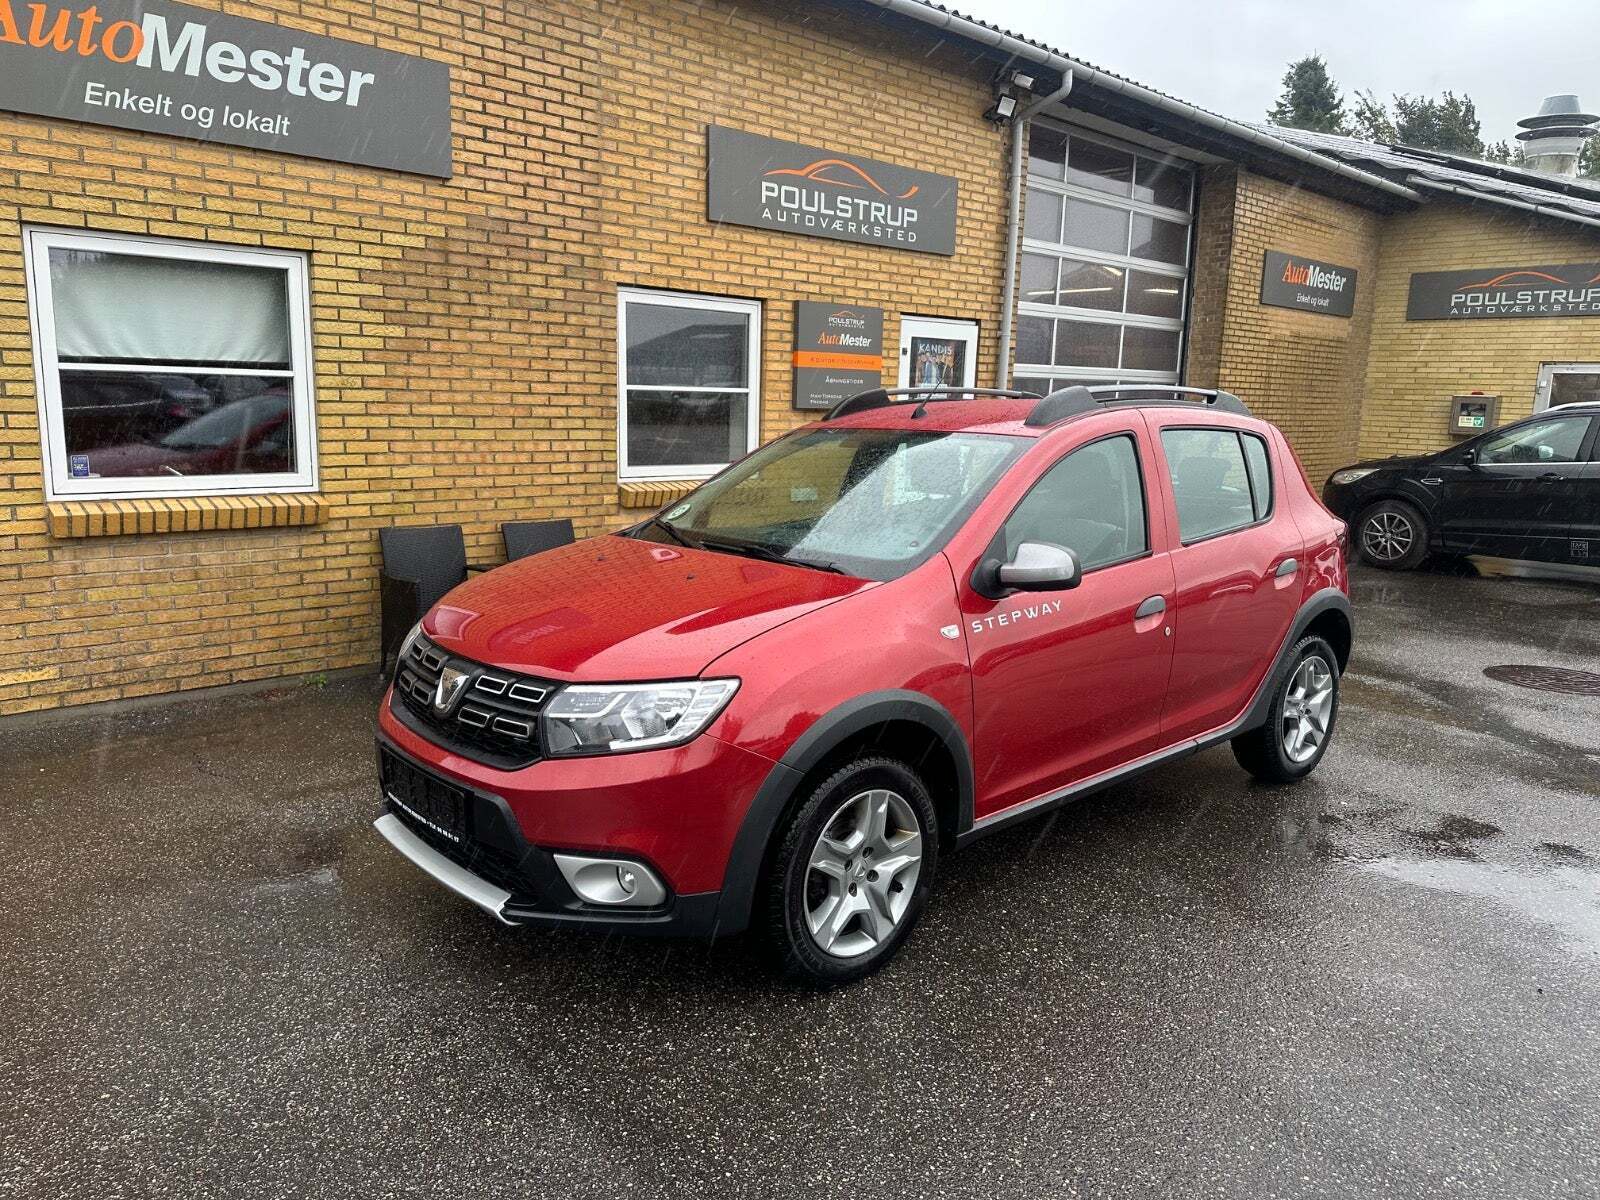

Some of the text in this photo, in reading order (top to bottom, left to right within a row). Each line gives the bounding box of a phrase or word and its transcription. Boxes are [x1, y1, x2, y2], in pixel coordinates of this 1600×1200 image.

[84, 81, 290, 137] Enkelt og lokalt
[761, 181, 918, 228] POULSTRUP
[762, 208, 917, 242] AUTOVÆRKSTED
[1281, 259, 1347, 292] AutoMester
[1450, 288, 1600, 306] POULSTRUP
[1450, 303, 1600, 315] AUTOVÆRKSTED
[817, 331, 872, 347] AutoMester
[918, 343, 953, 355] KANDIS
[971, 600, 1061, 633] STEPWAY
